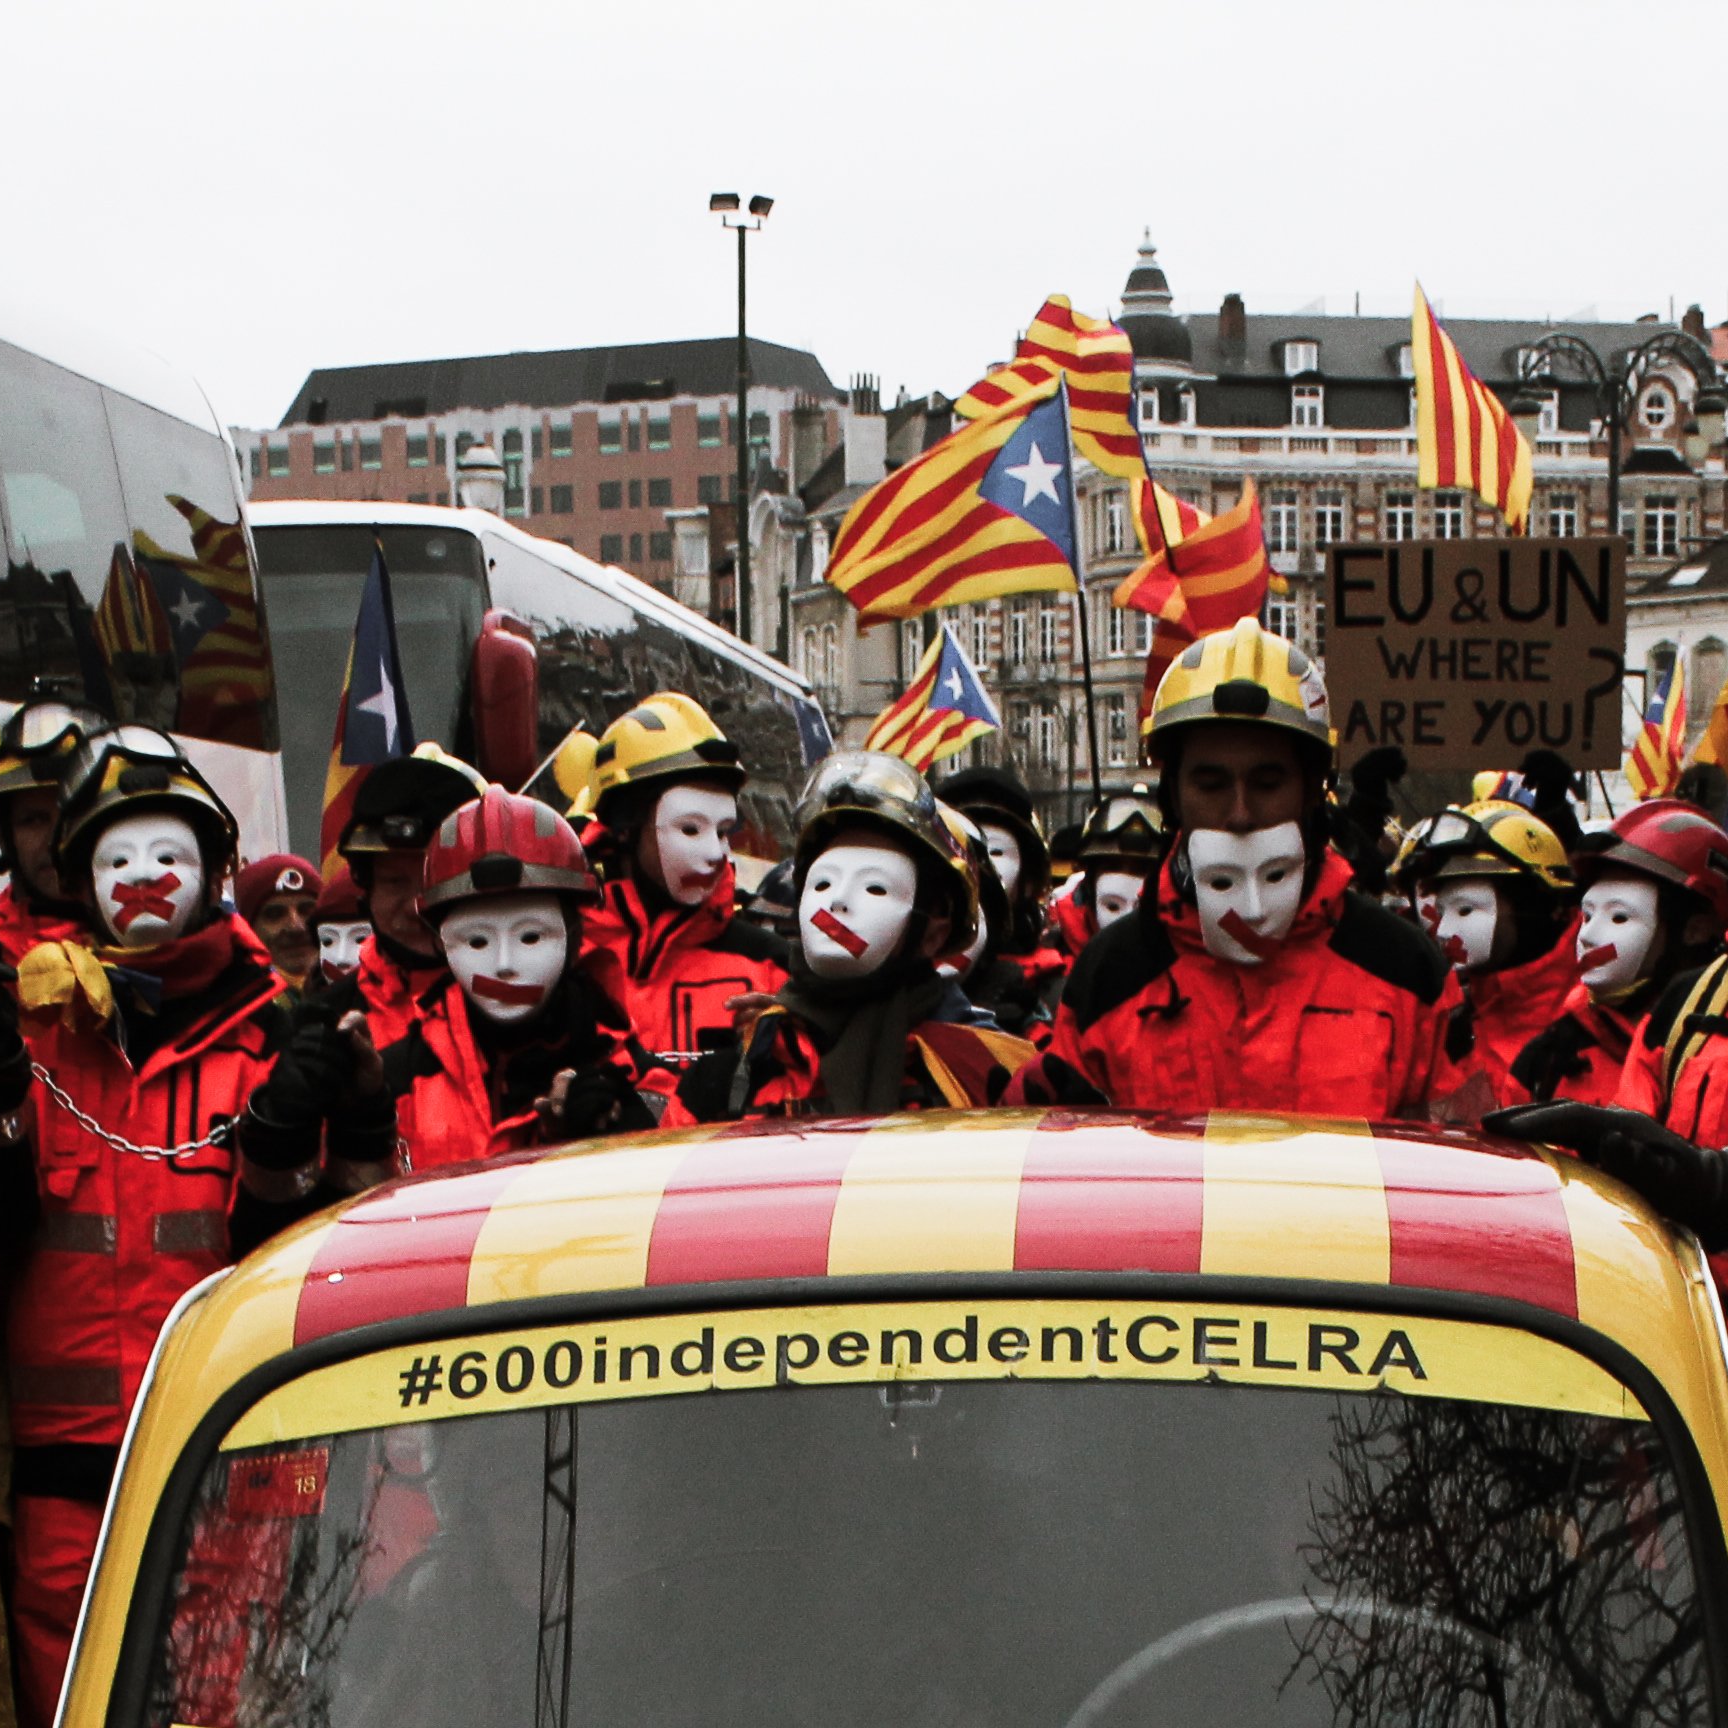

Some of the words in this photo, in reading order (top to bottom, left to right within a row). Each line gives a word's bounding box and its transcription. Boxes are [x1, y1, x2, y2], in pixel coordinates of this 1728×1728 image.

[1333, 547, 1434, 628] EU
[1450, 567, 1491, 623] &
[1498, 547, 1611, 628] UN
[1344, 700, 1446, 746] ARE
[1472, 646, 1625, 751] YOU?
[1376, 636, 1553, 682] WHERE
[398, 1314, 1429, 1408] #600independentCELRA
[295, 1475, 316, 1495] 18
